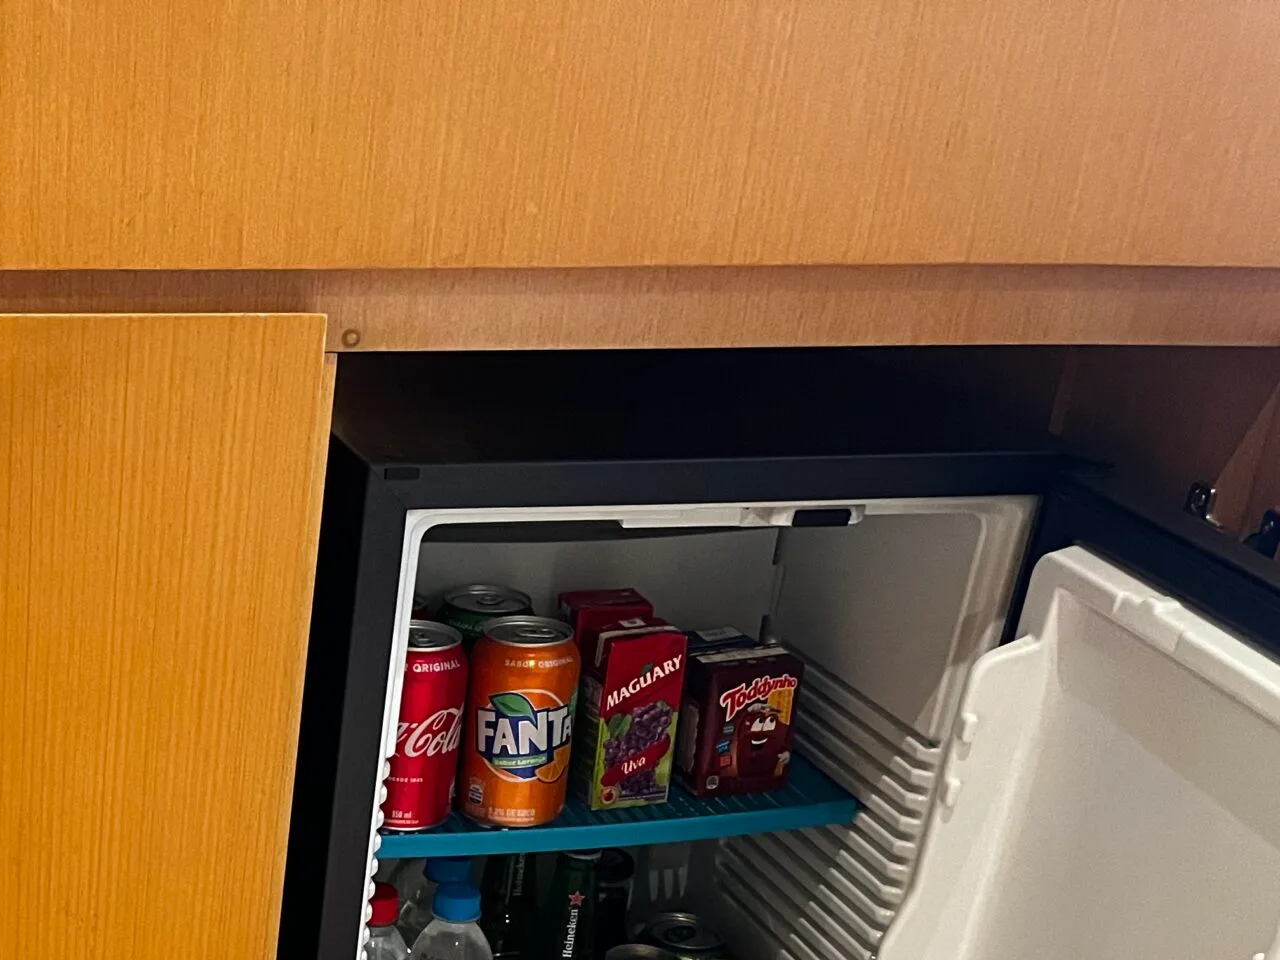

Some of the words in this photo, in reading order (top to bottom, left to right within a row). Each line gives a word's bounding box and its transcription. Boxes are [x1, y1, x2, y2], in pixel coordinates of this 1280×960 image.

[412, 659, 461, 673] ORIGINAL
[504, 659, 535, 668] SABOR
[538, 656, 573, 668] ORIGINAL
[606, 654, 682, 711] MAGUARY
[720, 674, 797, 722] Toddynho
[477, 706, 572, 755] FANTA
[621, 756, 646, 774] Uva
[562, 908, 578, 958] Heineken
